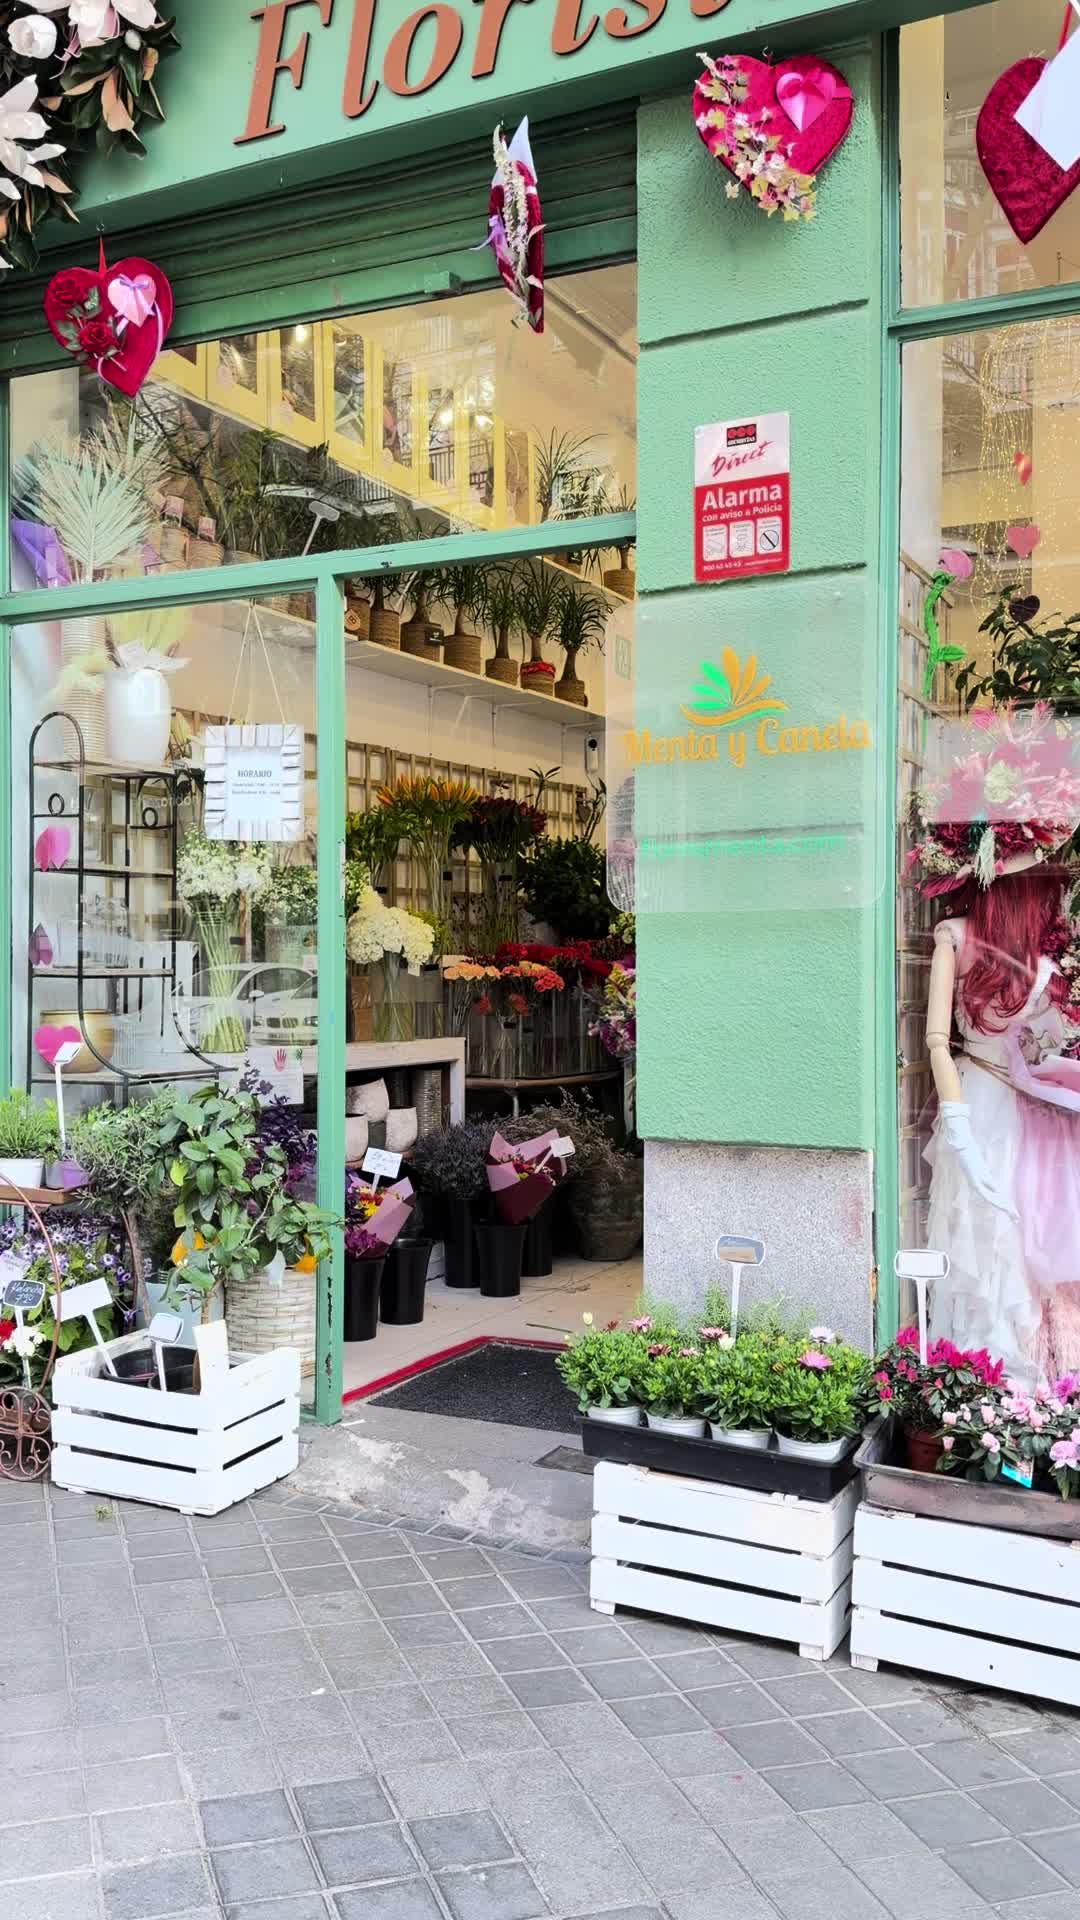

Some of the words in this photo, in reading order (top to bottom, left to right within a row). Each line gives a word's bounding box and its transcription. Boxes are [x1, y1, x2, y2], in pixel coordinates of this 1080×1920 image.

[233, 0, 735, 145] Floris
[712, 441, 774, 477] Direct
[703, 484, 783, 511] Alarma
[702, 514, 718, 522] con
[720, 510, 743, 520] aviso
[623, 727, 719, 767] Menta
[728, 731, 746, 768] y
[755, 713, 872, 757] Canela
